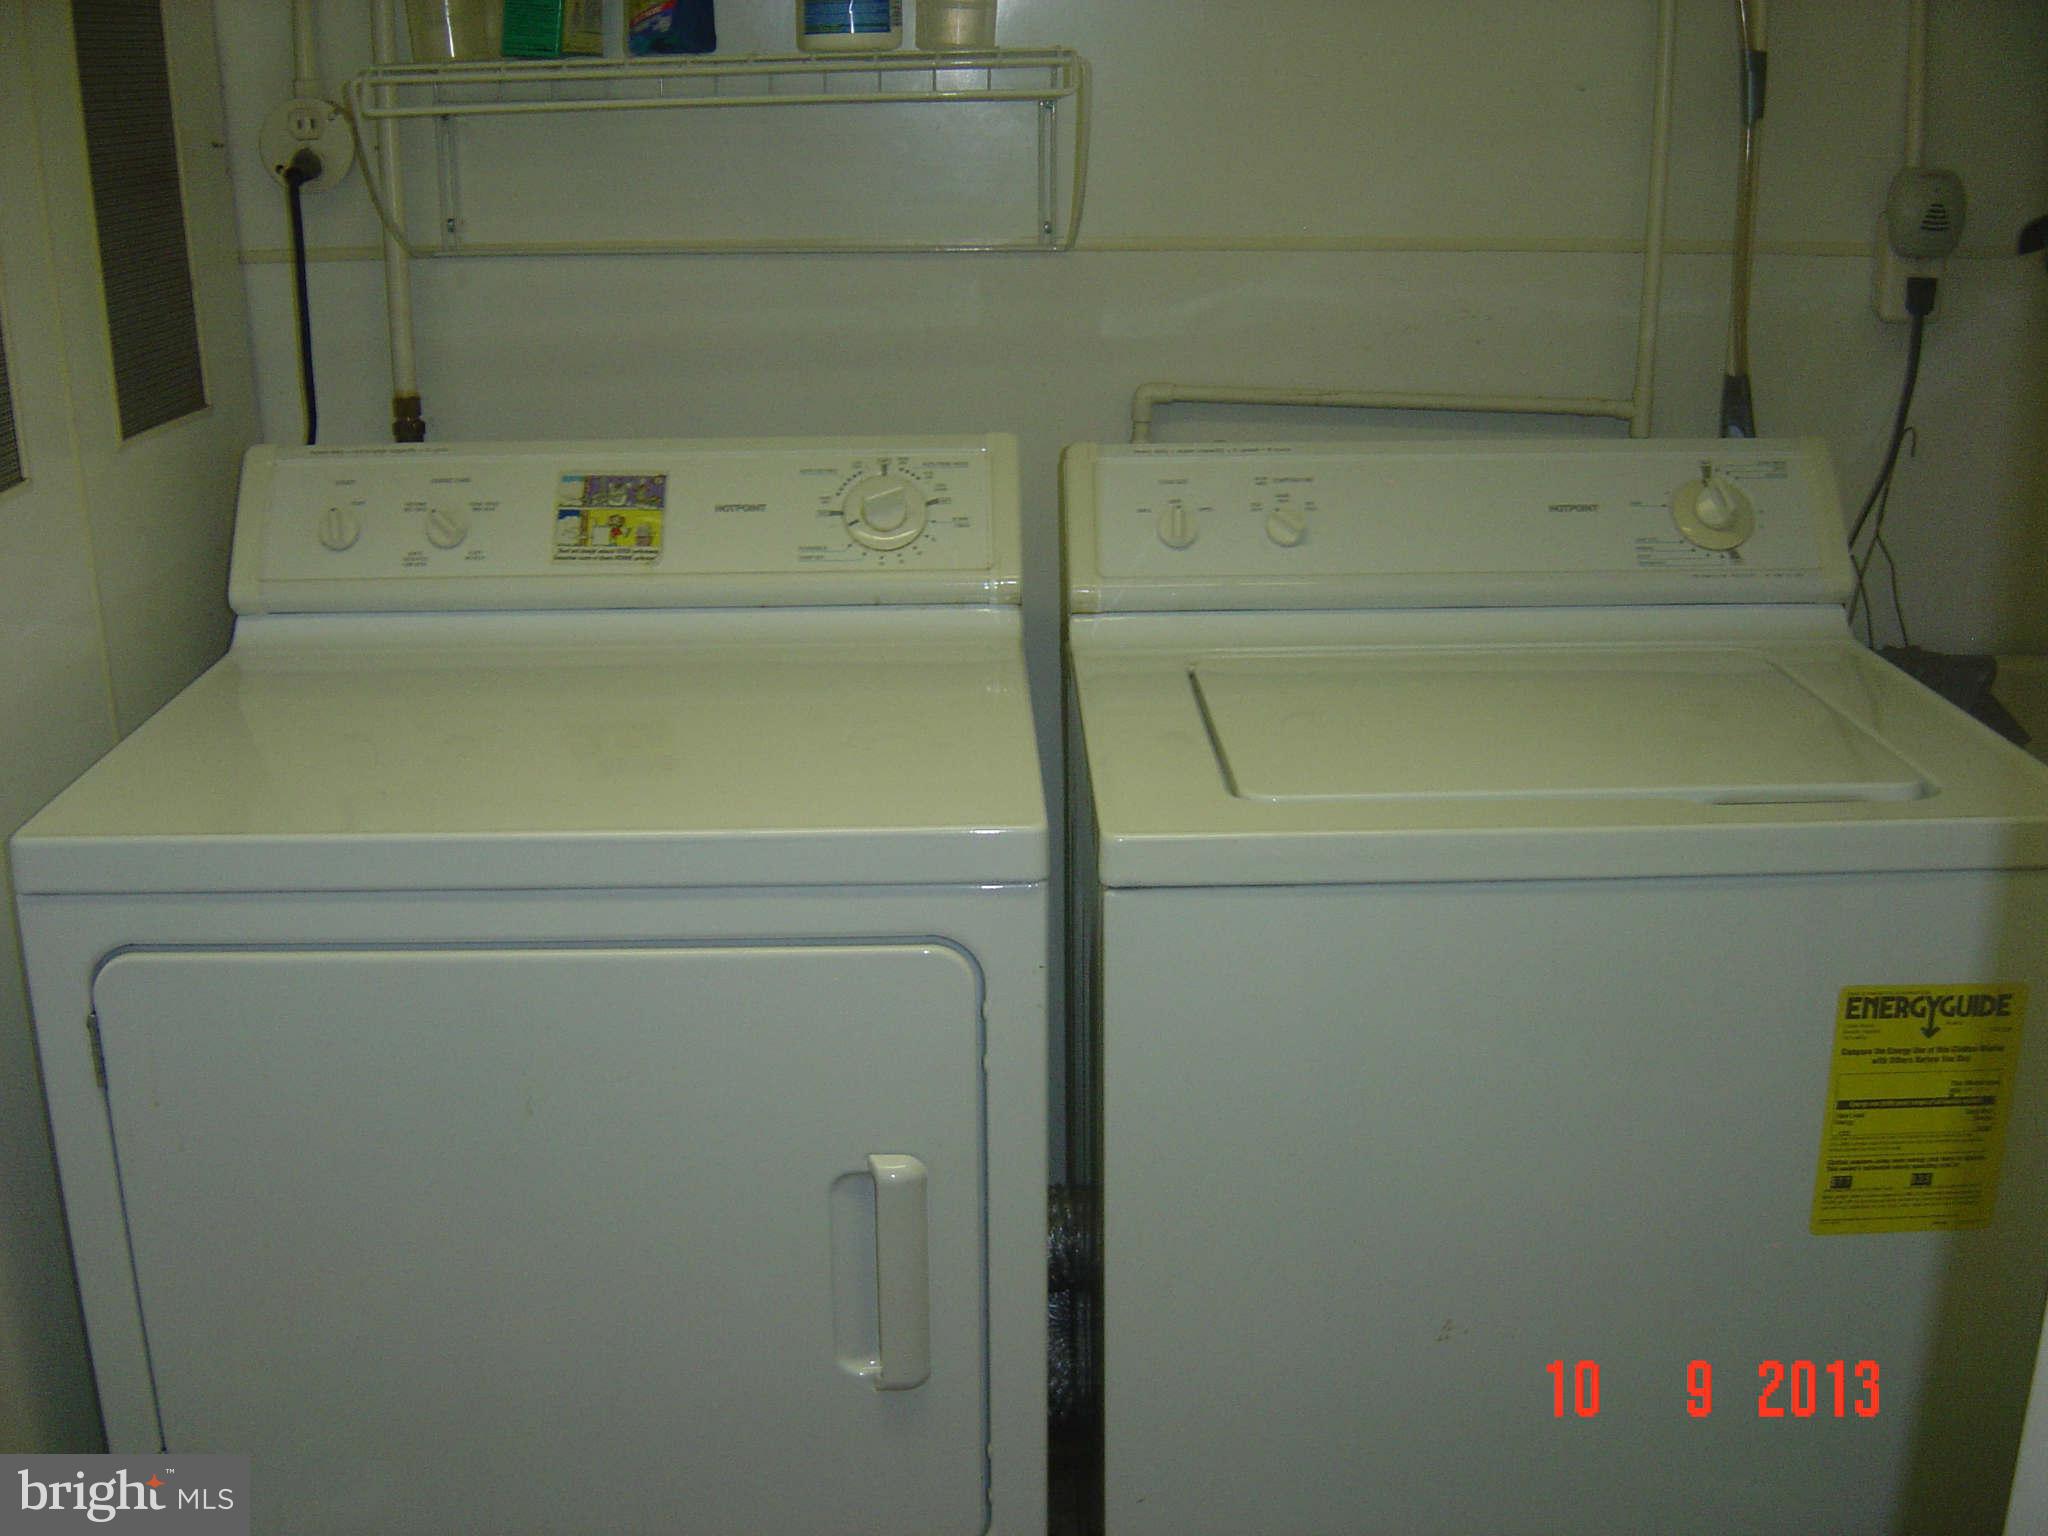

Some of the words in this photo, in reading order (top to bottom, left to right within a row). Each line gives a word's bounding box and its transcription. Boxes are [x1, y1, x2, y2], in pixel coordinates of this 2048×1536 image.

[714, 503, 767, 513] HOTPOINT
[1549, 503, 1598, 513] HOTPOINT
[1845, 992, 2013, 1020] ENERGYGUIDE
